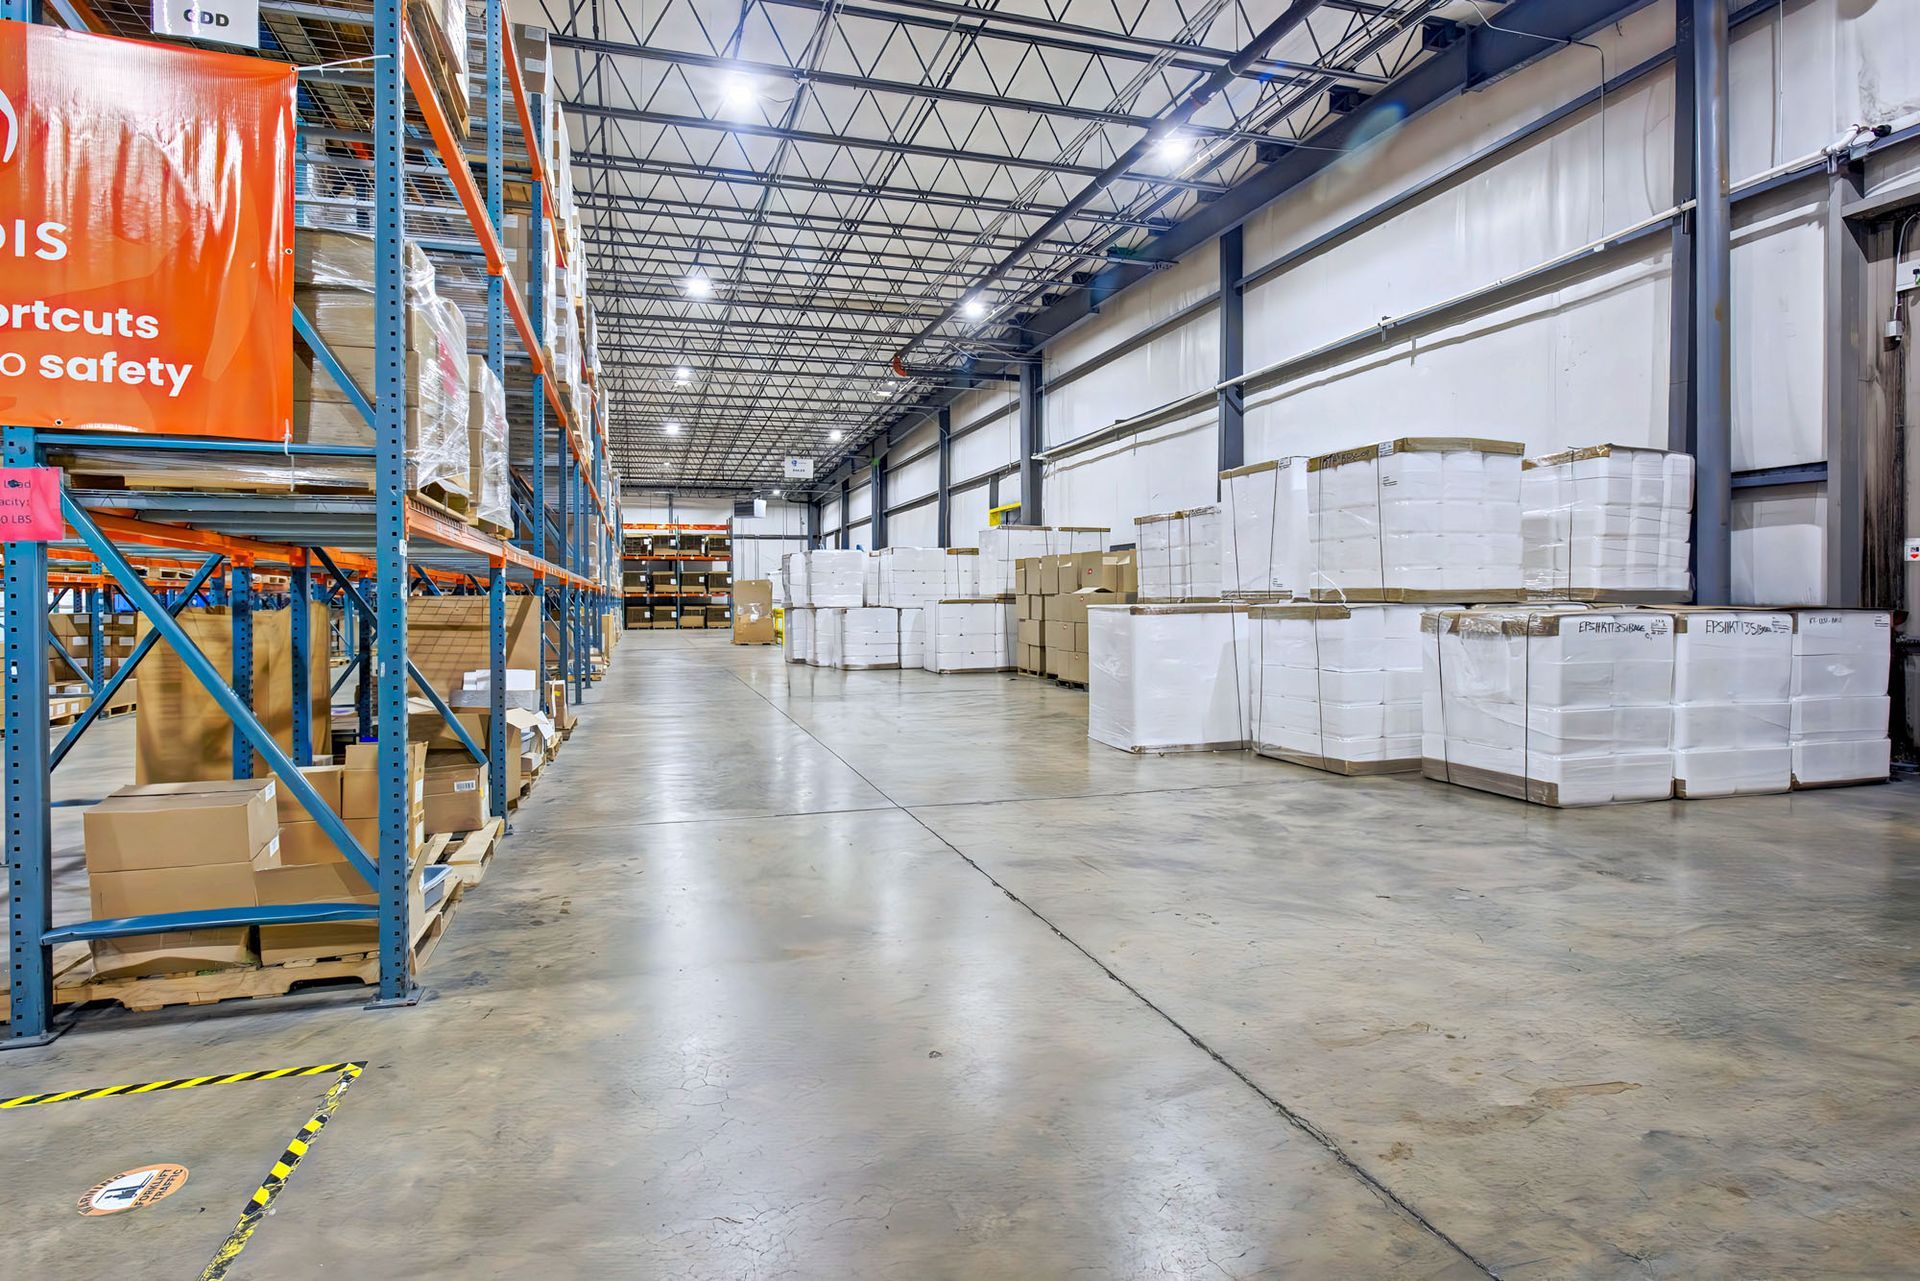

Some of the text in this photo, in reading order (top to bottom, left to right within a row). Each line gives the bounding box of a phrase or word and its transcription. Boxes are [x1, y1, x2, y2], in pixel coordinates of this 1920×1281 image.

[0, 219, 68, 261] IS
[39, 351, 193, 397] safety
[4, 479, 31, 489] Lad
[12, 515, 32, 524] LBS
